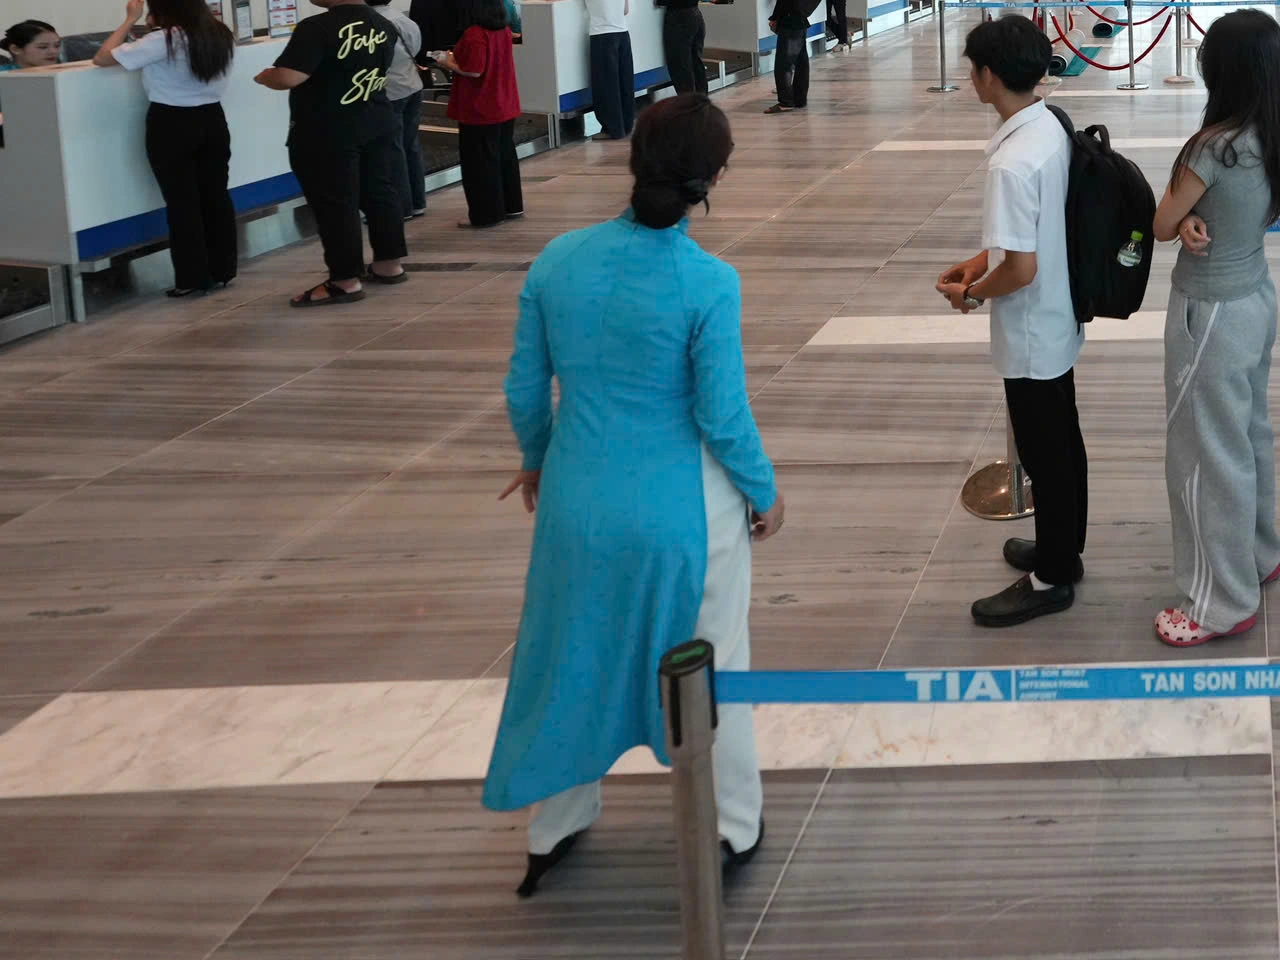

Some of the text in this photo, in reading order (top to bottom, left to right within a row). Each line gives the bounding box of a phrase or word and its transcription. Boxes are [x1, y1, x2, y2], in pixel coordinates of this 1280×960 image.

[905, 671, 1004, 701] TIA
[1140, 672, 1185, 693] TAN
[1193, 671, 1236, 691] SON
